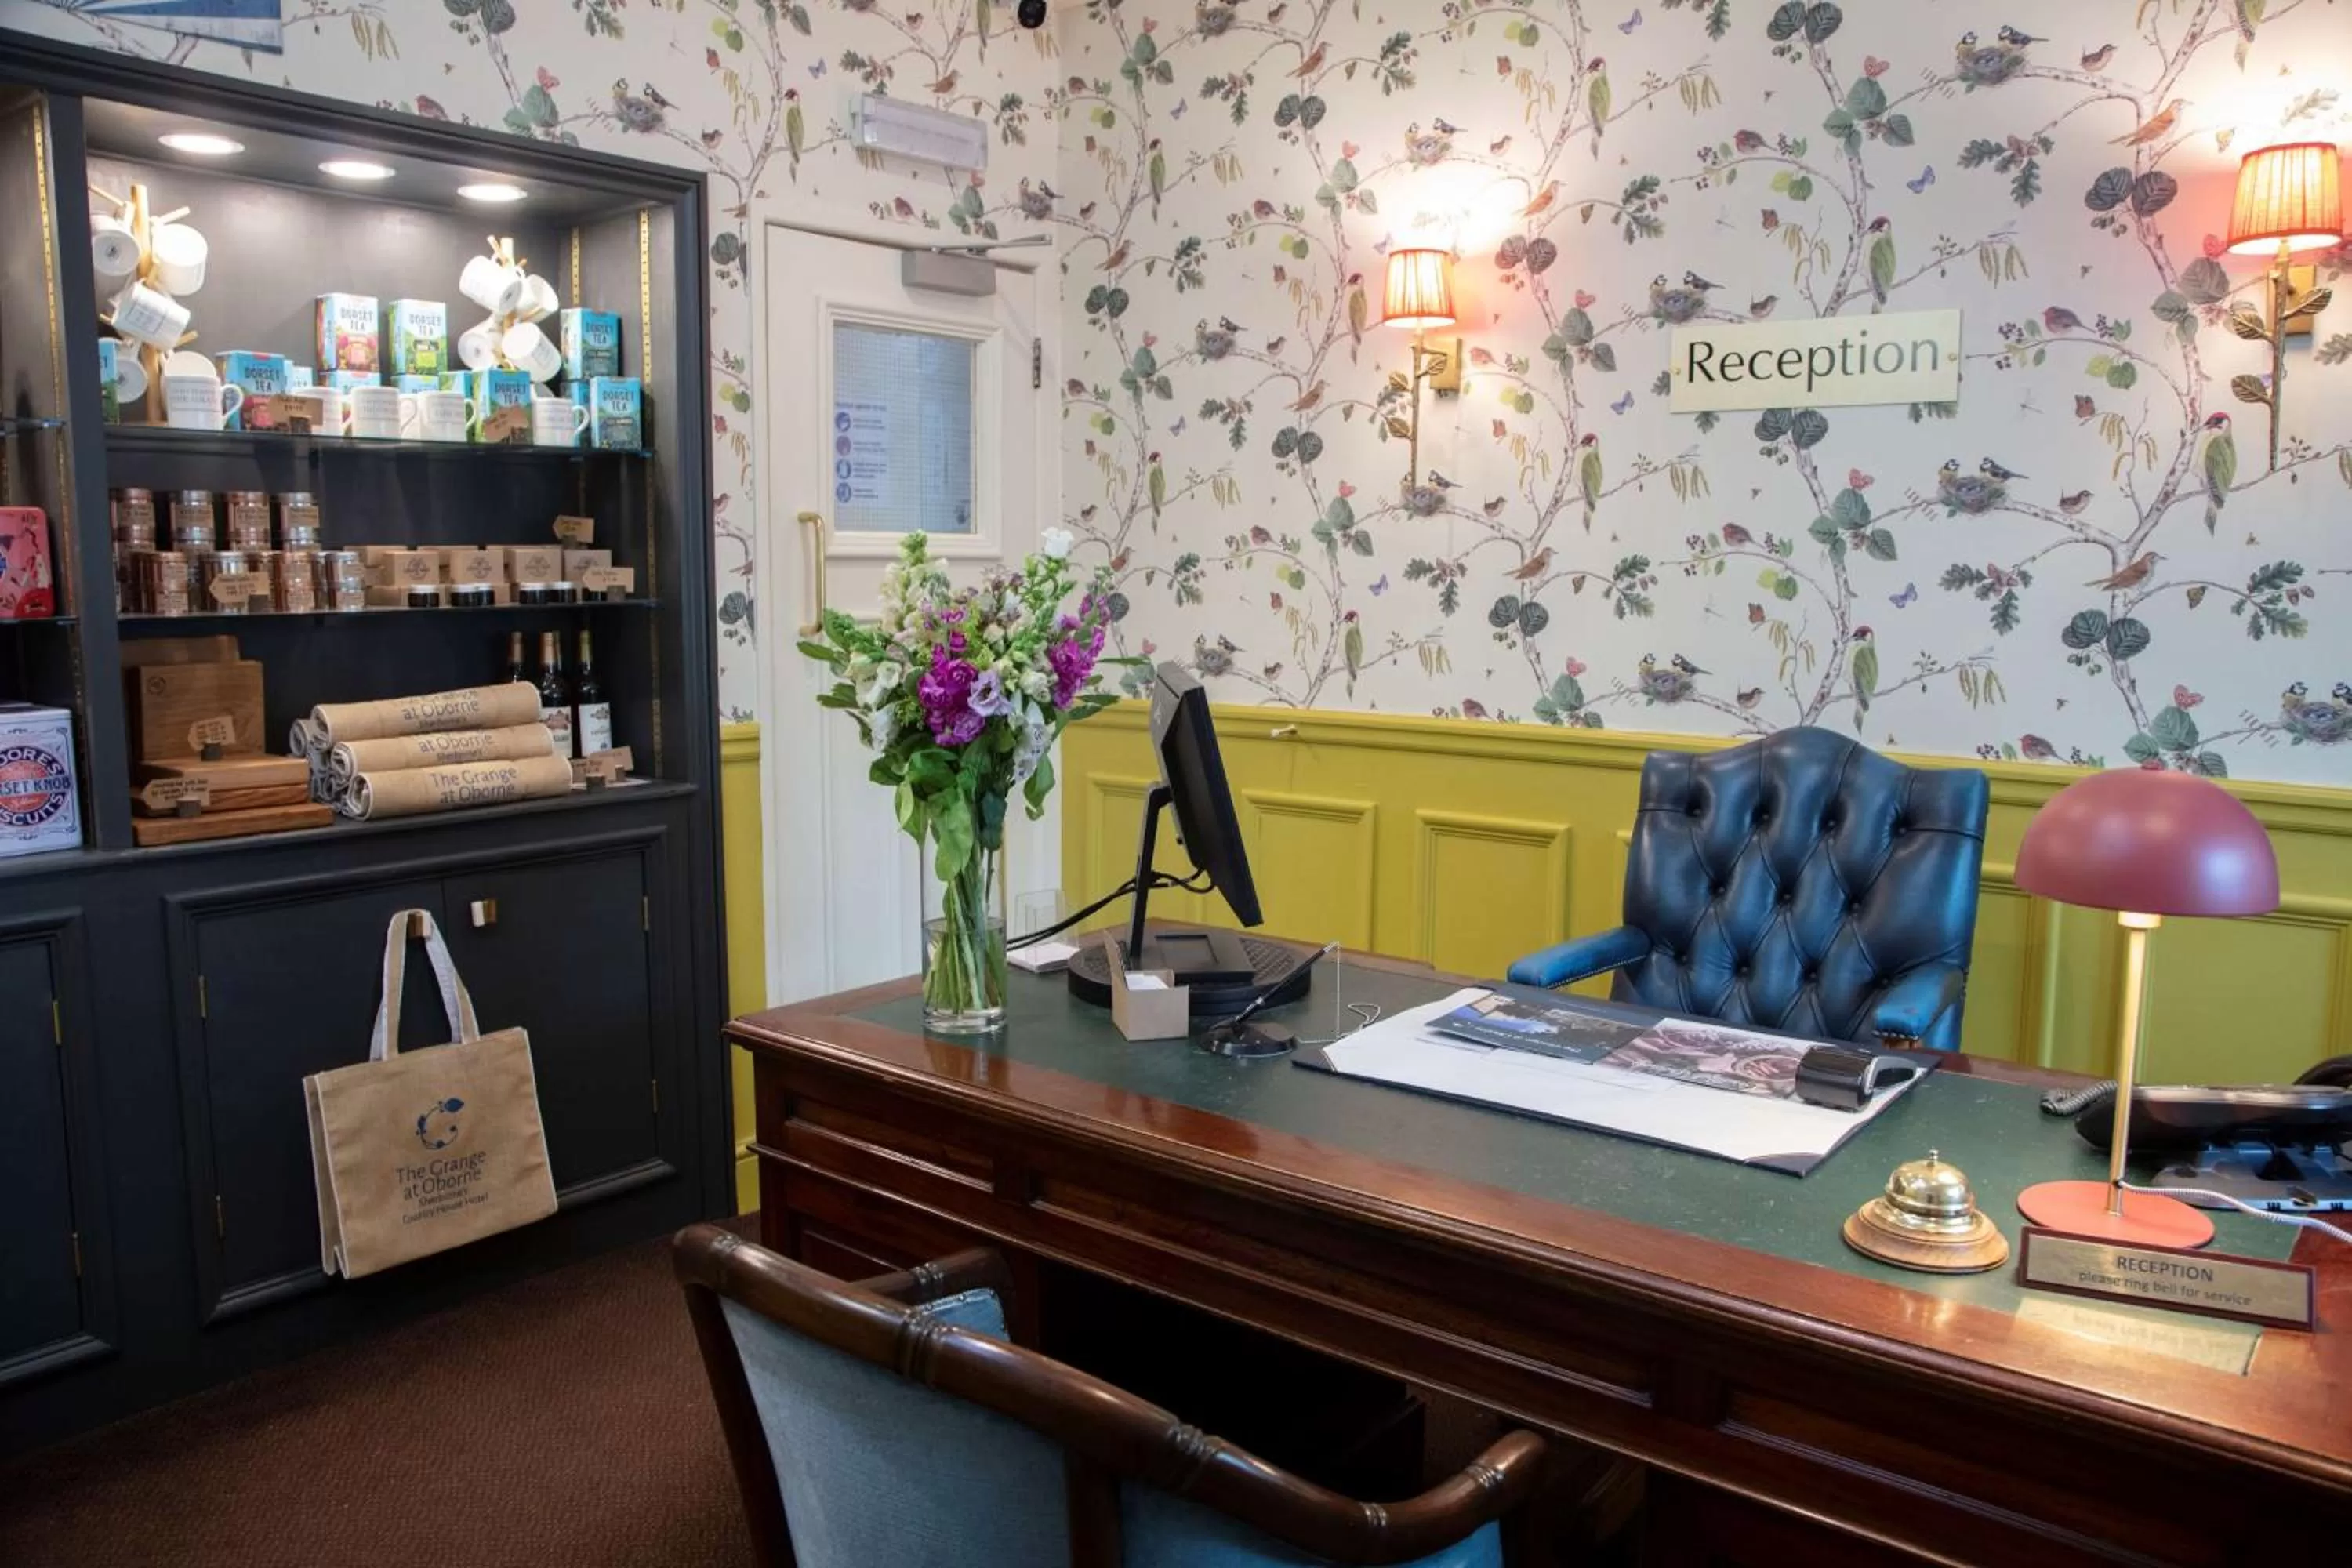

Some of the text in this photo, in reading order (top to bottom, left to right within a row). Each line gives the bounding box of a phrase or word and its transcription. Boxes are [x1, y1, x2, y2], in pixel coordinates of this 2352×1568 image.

[350, 320, 365, 331] TEA
[593, 332, 607, 343] TEA
[1688, 330, 1939, 393] Reception
[255, 379, 272, 392] TEA
[602, 390, 634, 401] DORSET
[612, 400, 628, 412] TEA
[421, 697, 481, 717] Oborne
[436, 734, 495, 750] Oborne
[34, 776, 71, 792] KNOB
[430, 768, 517, 788] The Grange
[440, 783, 515, 804] at Oborne
[396, 1151, 487, 1185] The Grange
[403, 1168, 483, 1201] at Oborne
[2116, 1255, 2215, 1283] RECEPTION
[2078, 1271, 2252, 1306] please ring bell for service
